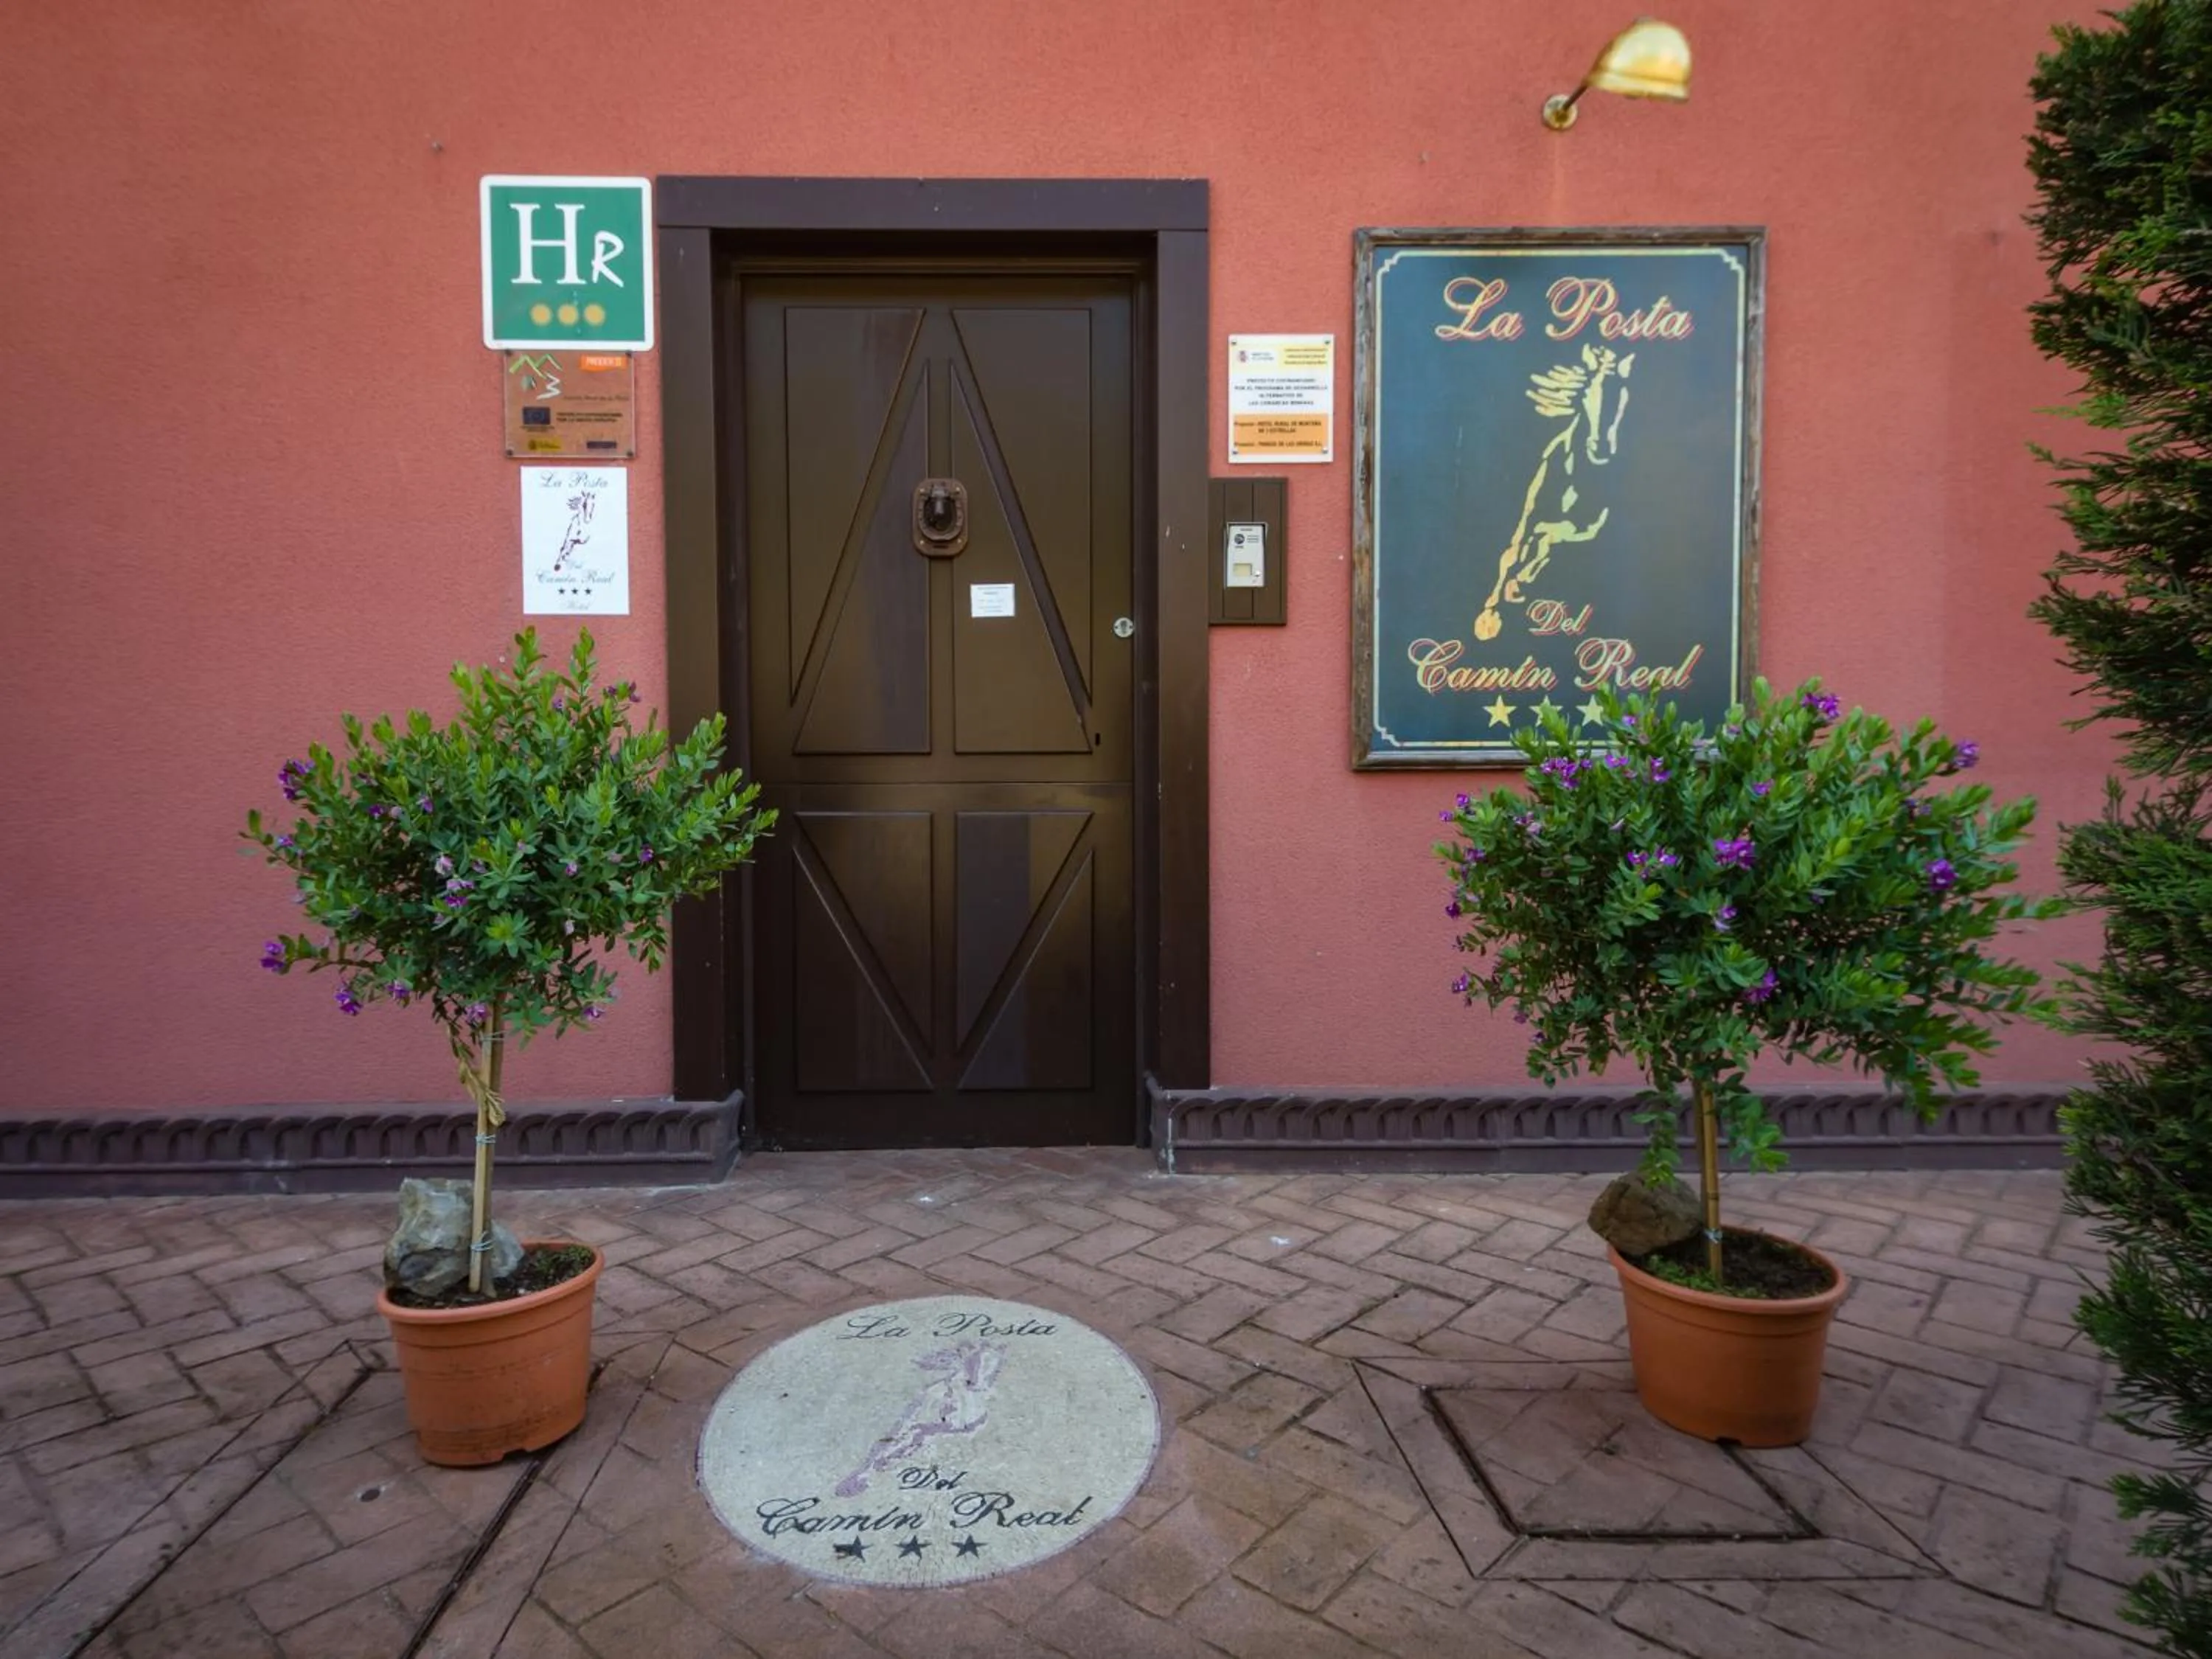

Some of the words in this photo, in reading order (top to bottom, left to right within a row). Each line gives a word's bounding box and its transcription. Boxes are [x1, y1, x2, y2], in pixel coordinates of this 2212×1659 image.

[1435, 276, 1525, 341] La
[1544, 276, 1694, 341] Posta
[540, 470, 562, 488] La
[568, 470, 608, 488] Posta
[1526, 599, 1593, 636] Del
[1408, 637, 1557, 695] Camín
[1573, 637, 1704, 692] Real
[837, 1315, 911, 1340] La
[933, 1312, 1057, 1338] Posta
[897, 1467, 967, 1491] Del
[757, 1497, 929, 1538] Camín
[950, 1492, 1093, 1530] Real
